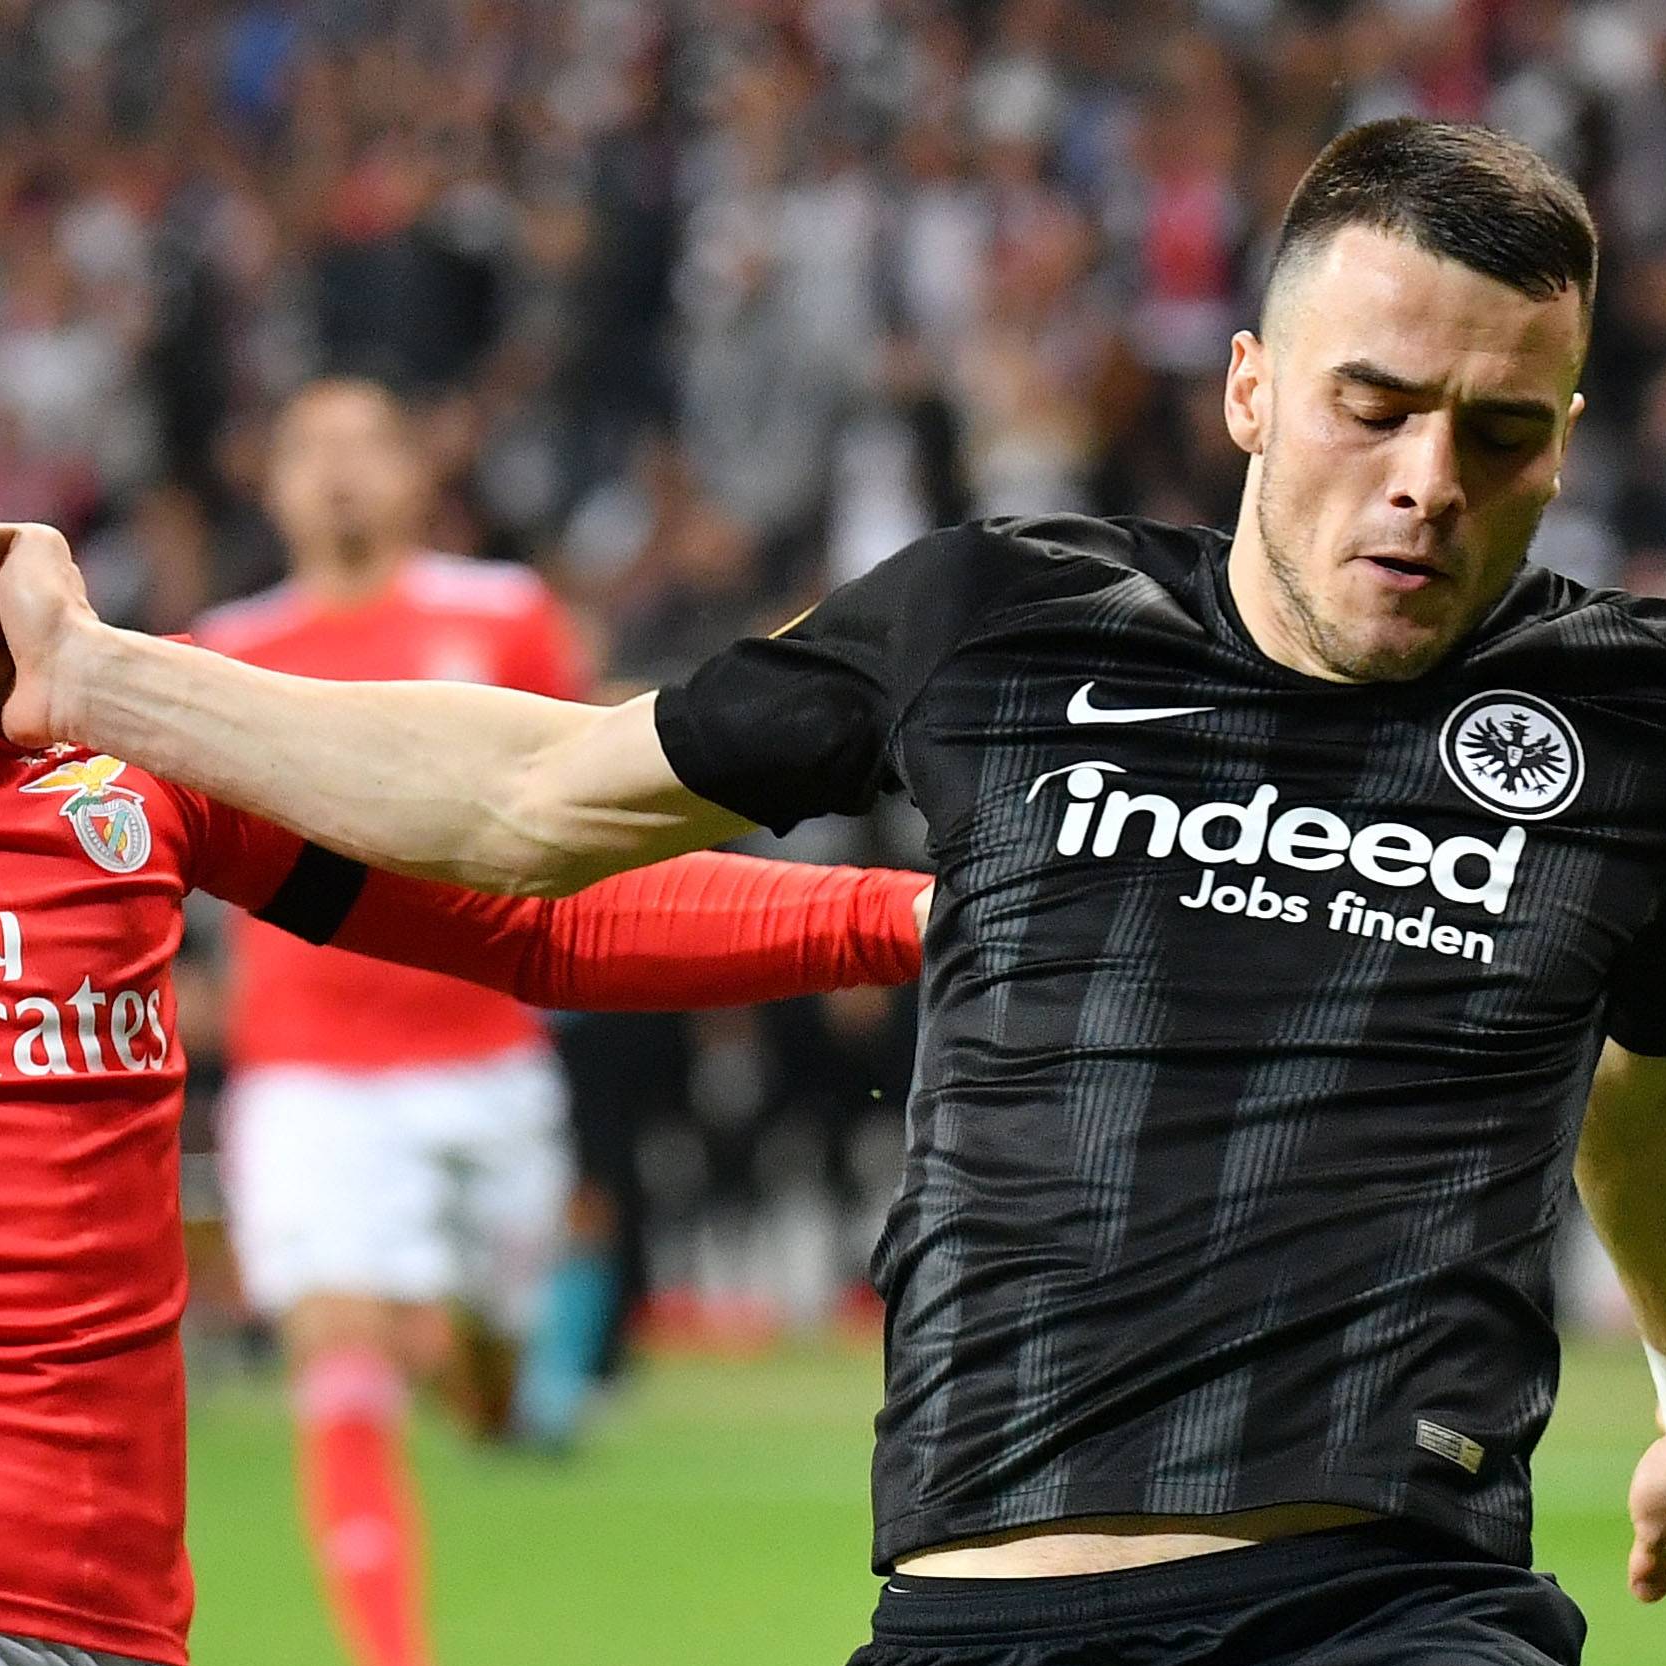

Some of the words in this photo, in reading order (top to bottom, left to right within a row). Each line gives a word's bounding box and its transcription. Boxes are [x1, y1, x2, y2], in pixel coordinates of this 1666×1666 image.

[1055, 765, 1527, 915] indeed
[1178, 868, 1310, 924] Jobs
[1326, 889, 1495, 965] finden
